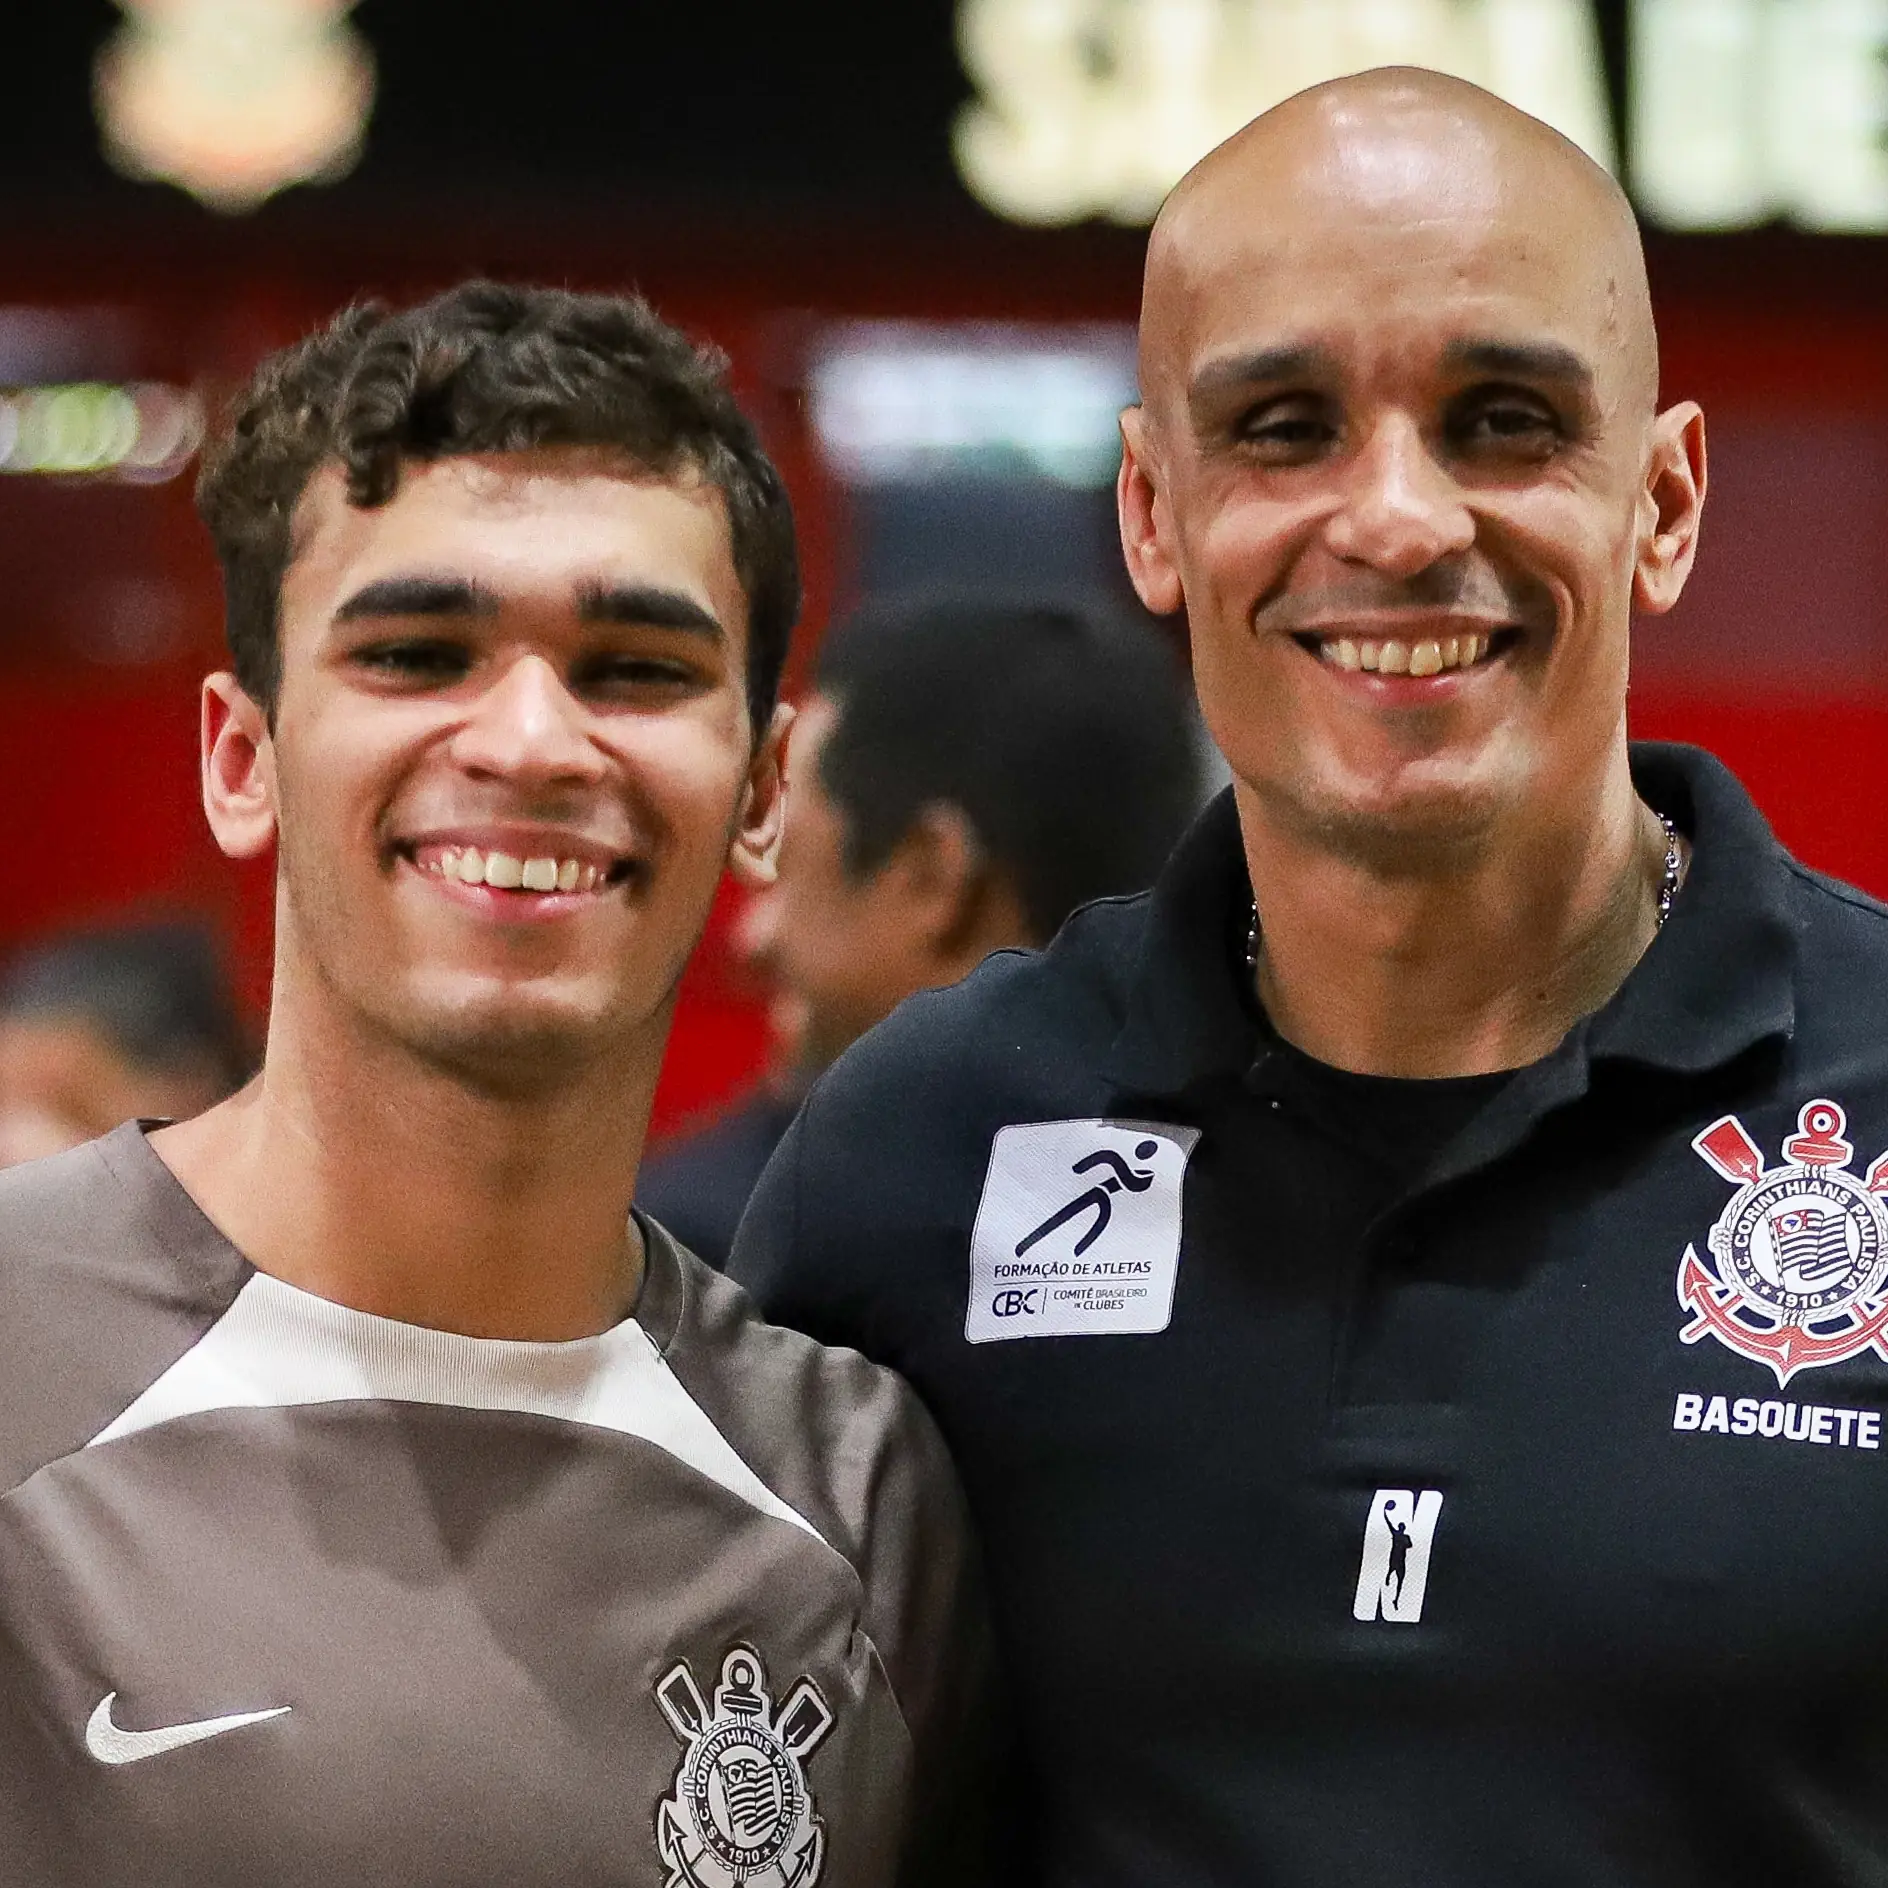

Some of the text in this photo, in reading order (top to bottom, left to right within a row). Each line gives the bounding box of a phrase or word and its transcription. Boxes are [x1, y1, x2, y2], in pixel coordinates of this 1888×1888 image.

[1734, 1180, 1852, 1248] CORINTHIANS
[1840, 1203, 1877, 1291] PAULISTA
[994, 1261, 1152, 1279] FORMAÇÃO DE ATLETAS
[992, 1288, 1039, 1317] CBC
[1083, 1300, 1124, 1310] CLUBES
[1775, 1291, 1823, 1309] 1910
[1673, 1393, 1881, 1449] BASQUETE
[696, 1729, 772, 1798] CORINTHIANS
[772, 1754, 792, 1845] PAULISTA
[728, 1847, 760, 1864] 1910
